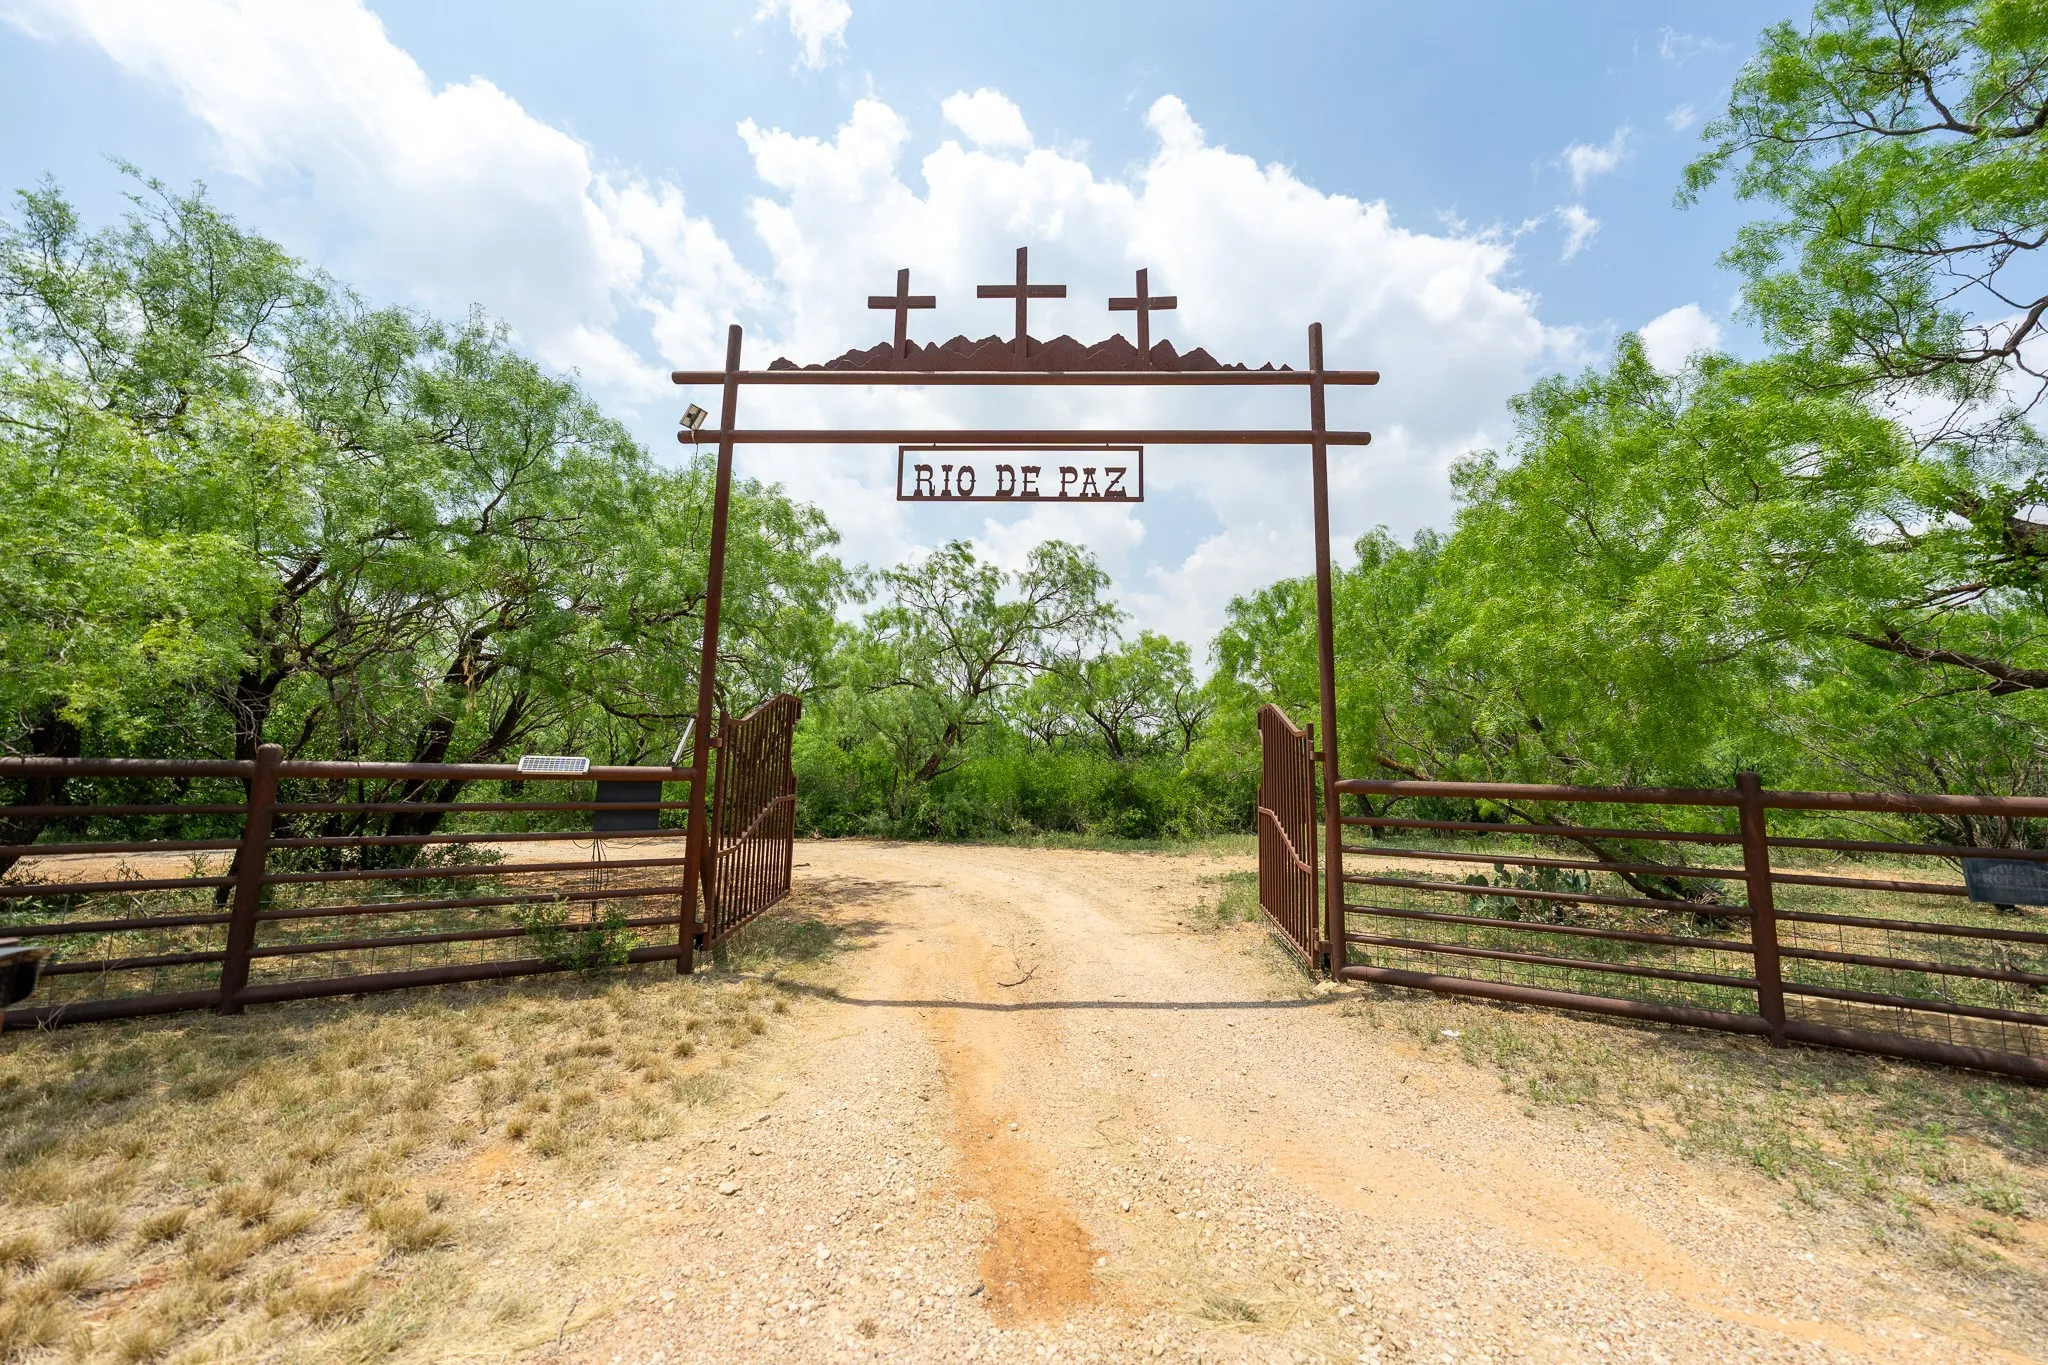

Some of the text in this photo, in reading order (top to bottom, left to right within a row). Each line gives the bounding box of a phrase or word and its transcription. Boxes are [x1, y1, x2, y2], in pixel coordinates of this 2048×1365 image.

[913, 464, 1127, 498] RIO DE PAZ
